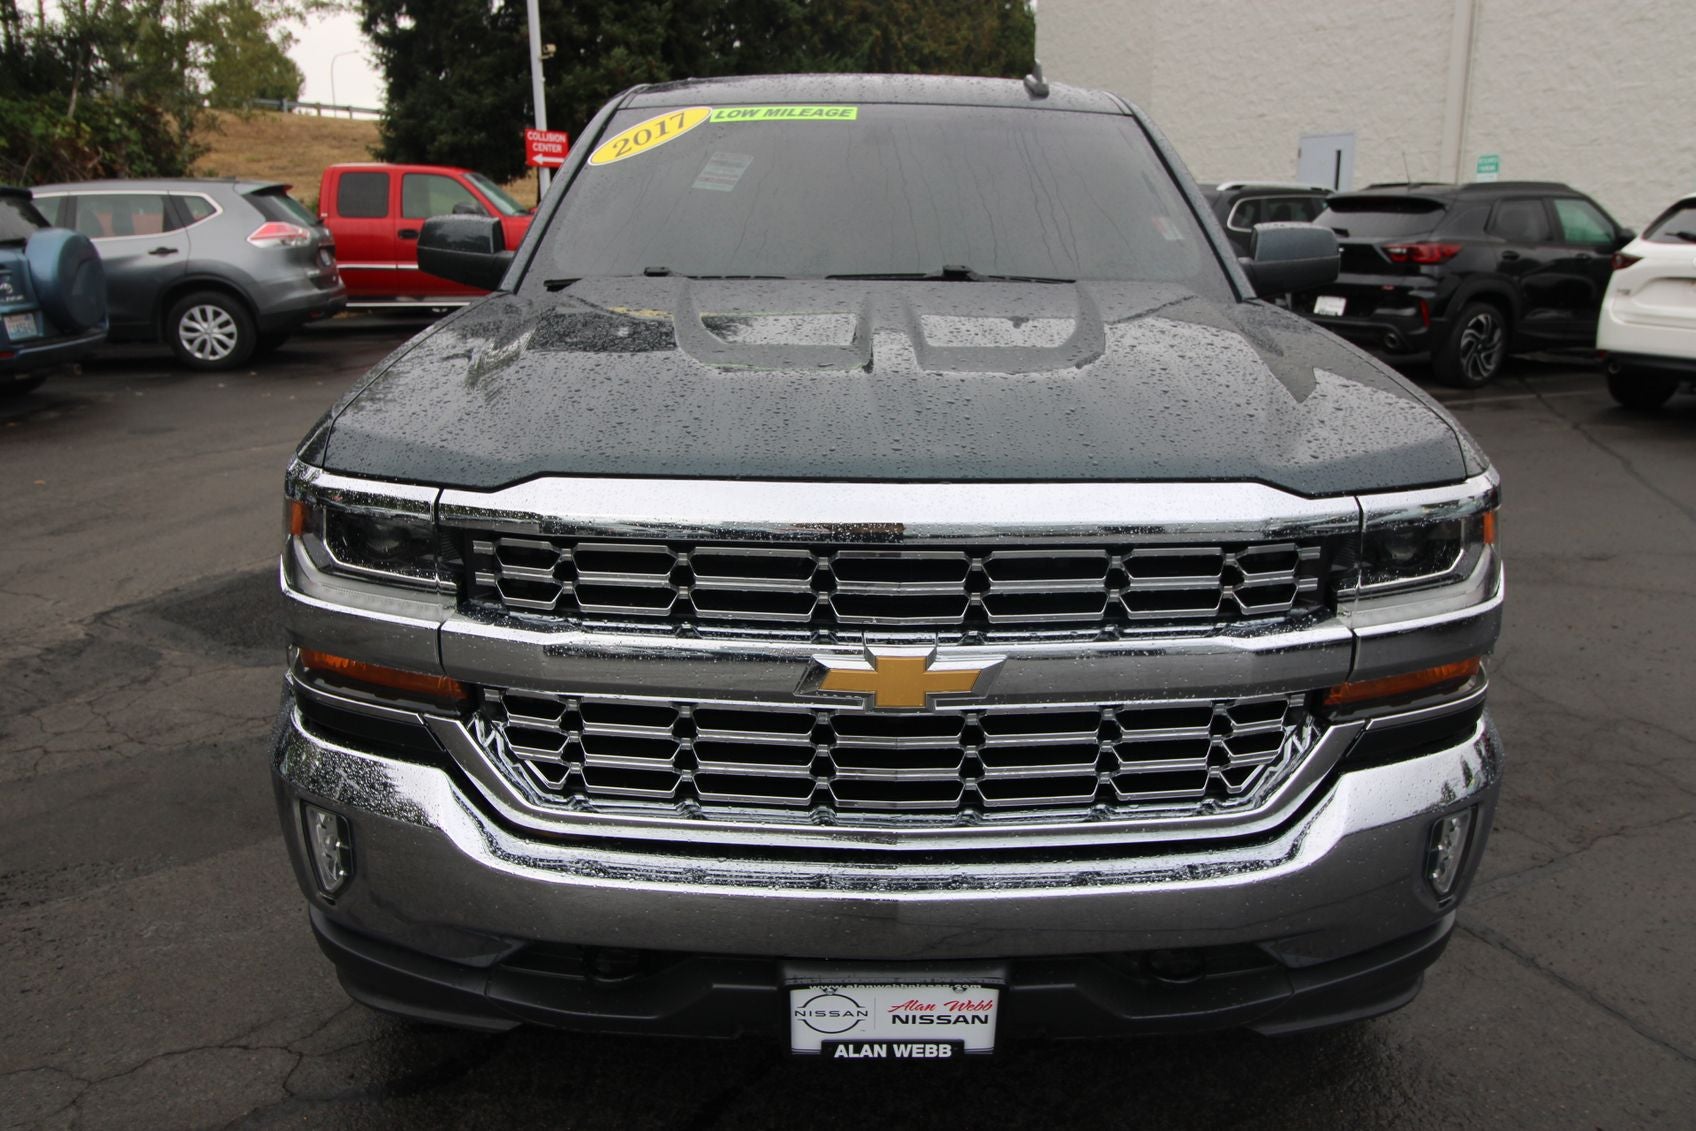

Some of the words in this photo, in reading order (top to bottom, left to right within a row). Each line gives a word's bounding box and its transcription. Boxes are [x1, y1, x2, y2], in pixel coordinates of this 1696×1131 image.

[714, 108, 761, 119] LOW
[764, 107, 853, 118] MILEAGE
[527, 131, 567, 143] COLLISION
[612, 111, 686, 159] 2017
[532, 142, 563, 153] CENTER
[888, 999, 937, 1013] Alan
[943, 999, 994, 1012] Webb
[794, 1010, 869, 1018] NISSAN
[891, 1014, 989, 1025] NISSAN
[833, 1044, 887, 1058] ALAN
[892, 1043, 952, 1058] WEBB
